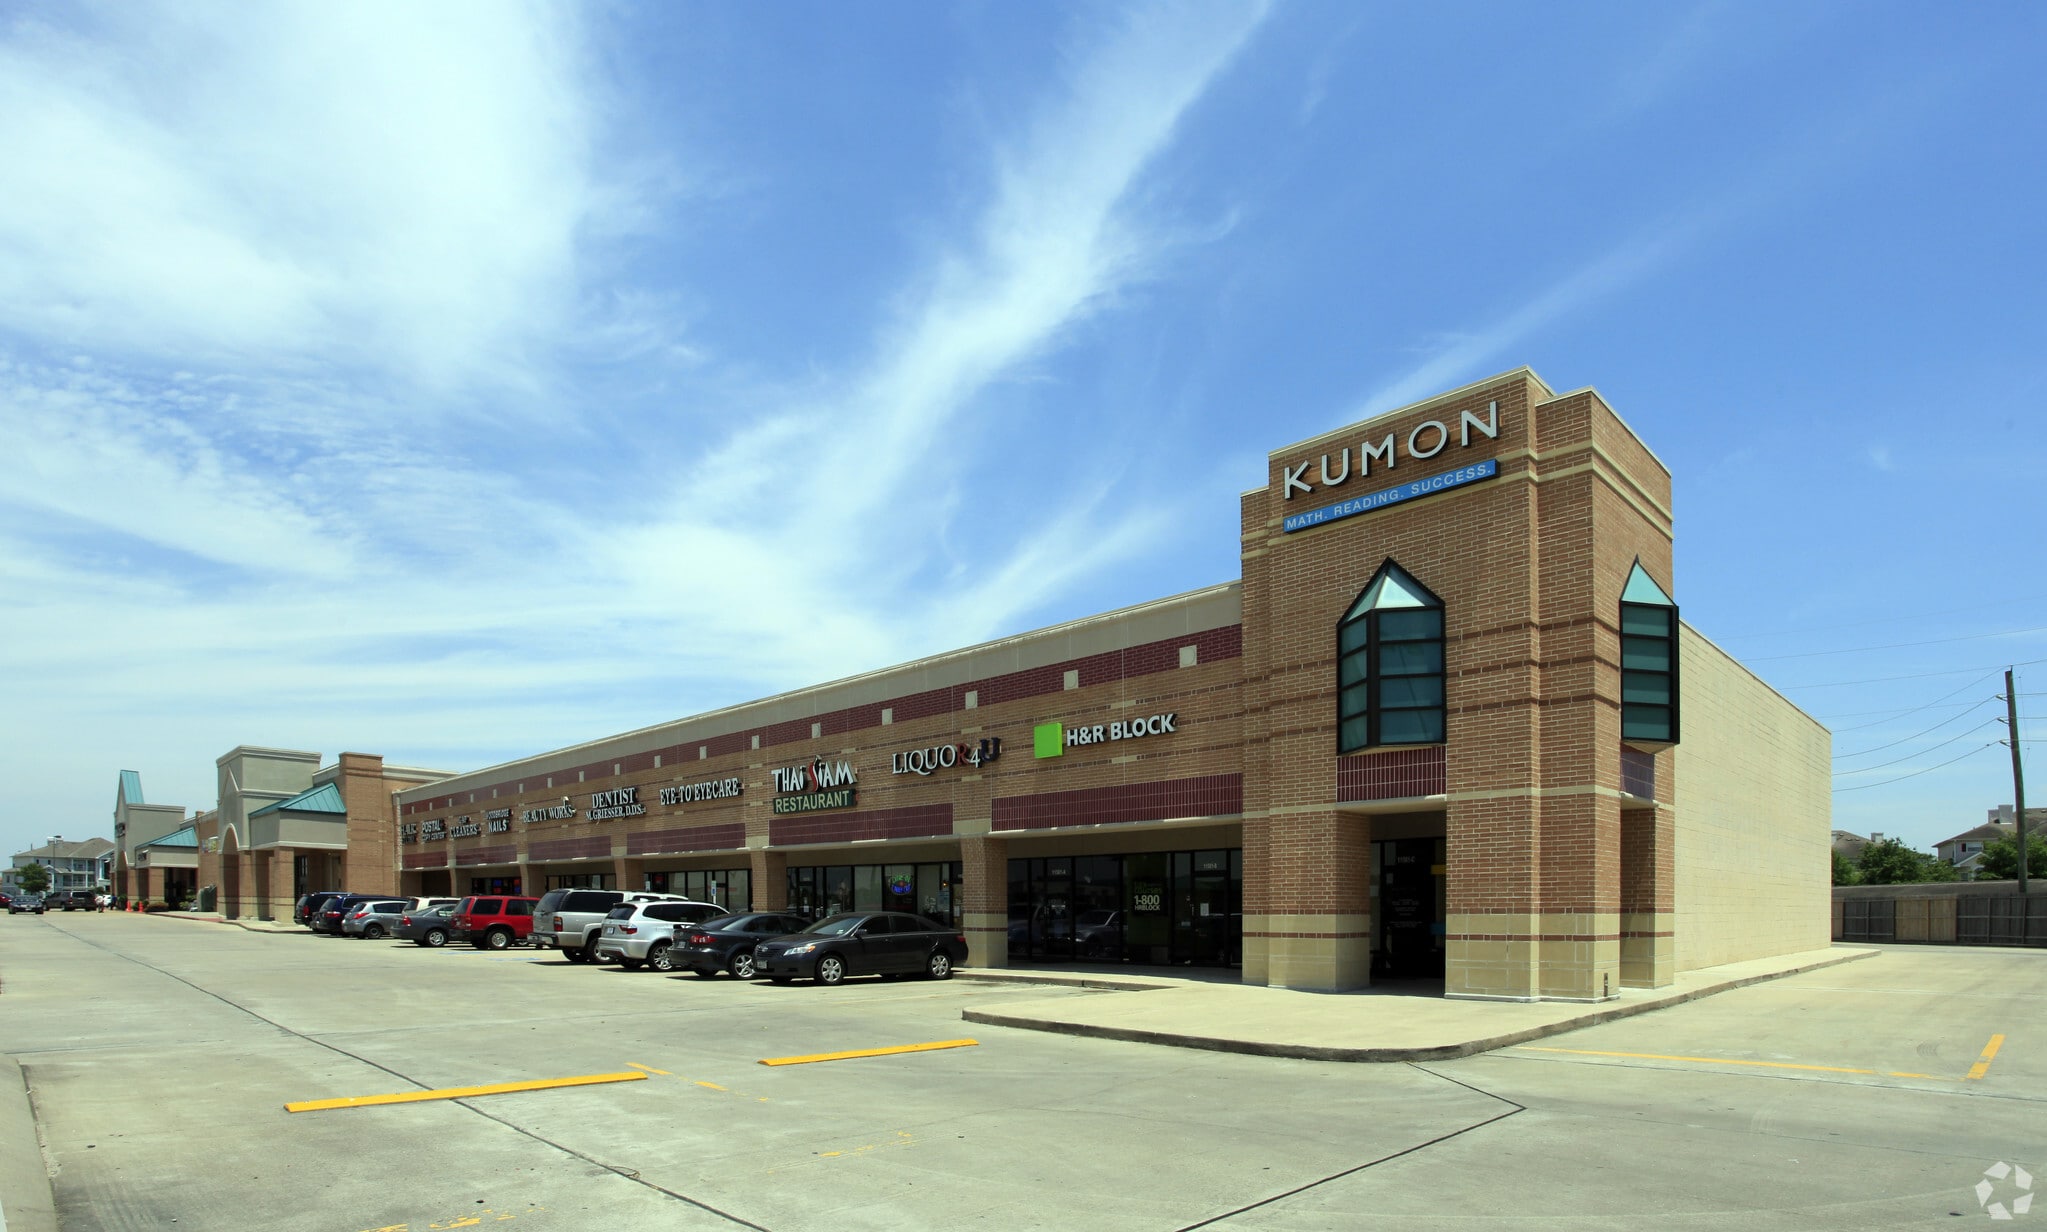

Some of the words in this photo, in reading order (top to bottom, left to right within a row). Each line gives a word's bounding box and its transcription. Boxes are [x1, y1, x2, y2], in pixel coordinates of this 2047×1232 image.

[1284, 401, 1498, 500] KUMON
[1286, 511, 1329, 530] MATH.
[1334, 490, 1404, 516] READING.
[1411, 464, 1492, 495] SUCCESS.
[1066, 725, 1105, 747] H&R
[1110, 713, 1177, 741] BLOCK
[591, 787, 635, 809] DENTIST
[694, 777, 739, 801] EYECARE
[523, 808, 547, 823] BEAUTY
[549, 803, 574, 819] WORKS
[775, 790, 850, 814] RESTAURANT
[422, 819, 441, 833] POSTAL
[450, 823, 479, 837] CLEANERS
[488, 819, 508, 833] NAILS
[1134, 895, 1160, 905] 1-800
